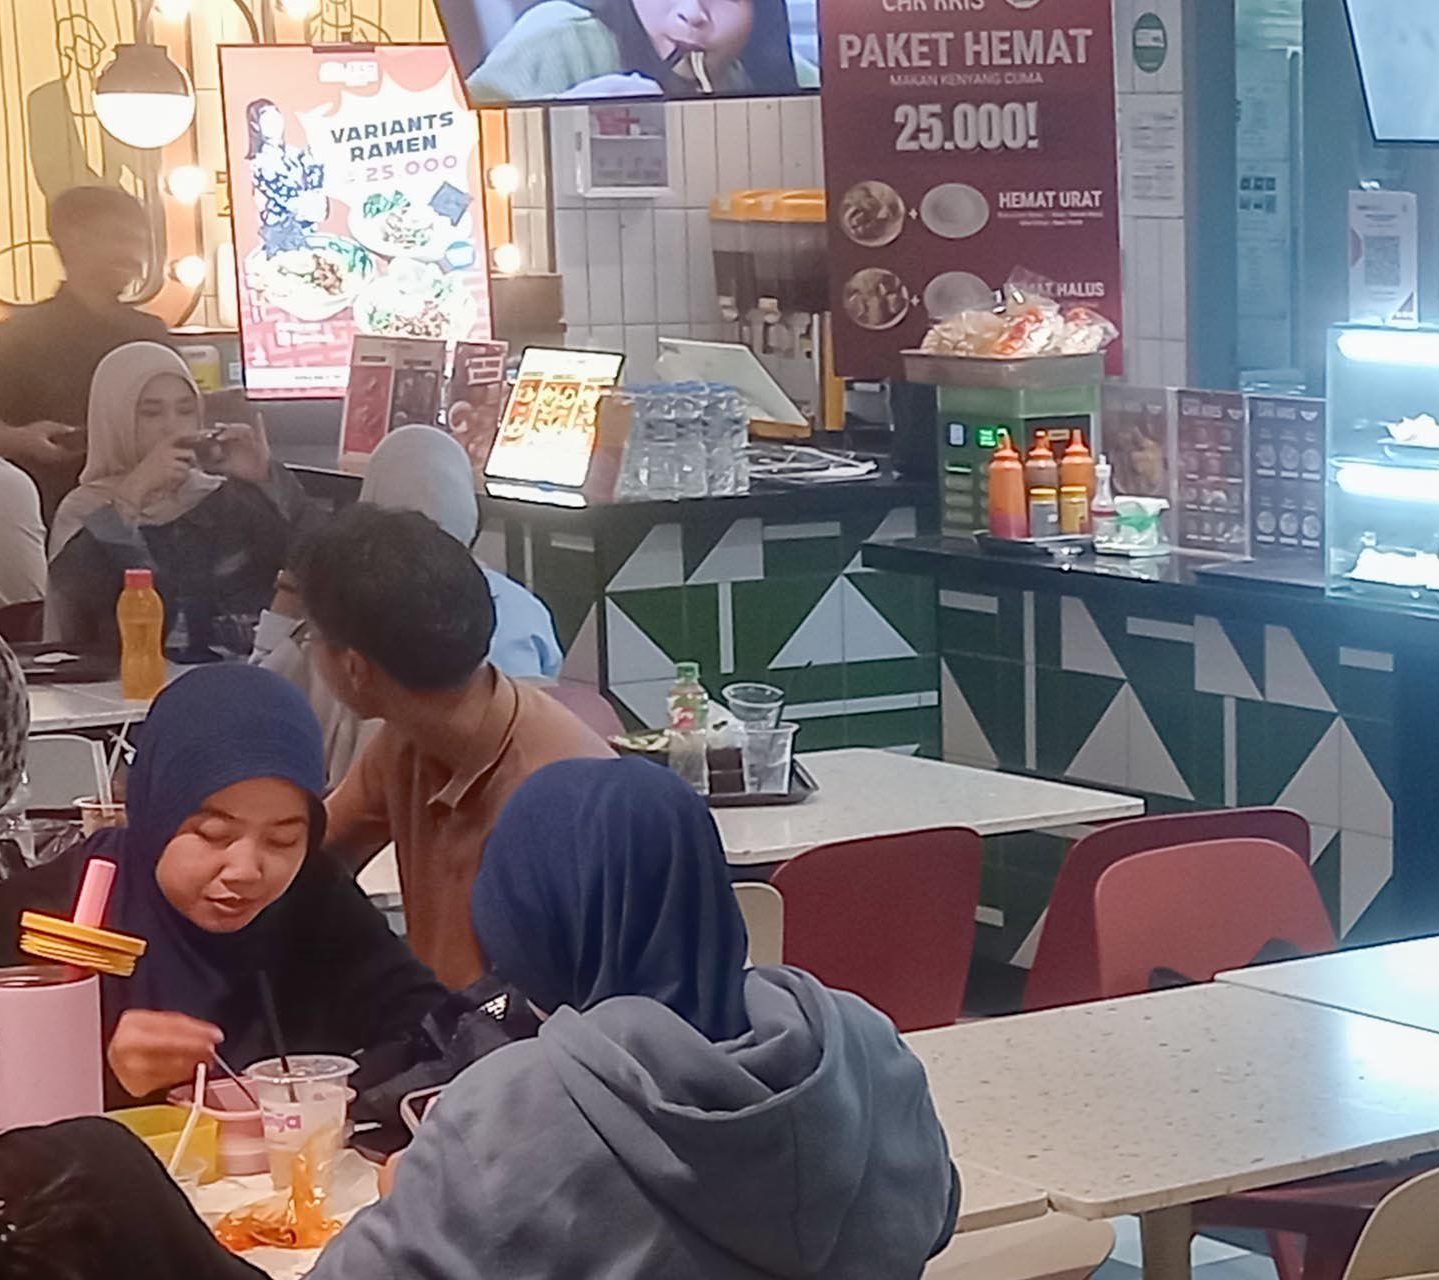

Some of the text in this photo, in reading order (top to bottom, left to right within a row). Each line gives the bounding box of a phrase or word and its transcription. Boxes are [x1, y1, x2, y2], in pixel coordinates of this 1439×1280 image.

[838, 28, 1093, 69] PAKET HEMAT
[889, 74, 938, 87] MAKAN
[940, 73, 1001, 87] KENYANG
[330, 111, 455, 145] VARIANTS
[894, 100, 1040, 152] 25.000!
[350, 134, 438, 163] RAMEN
[999, 190, 1103, 209] HEMAT URAT
[1056, 281, 1105, 297] HALUS
